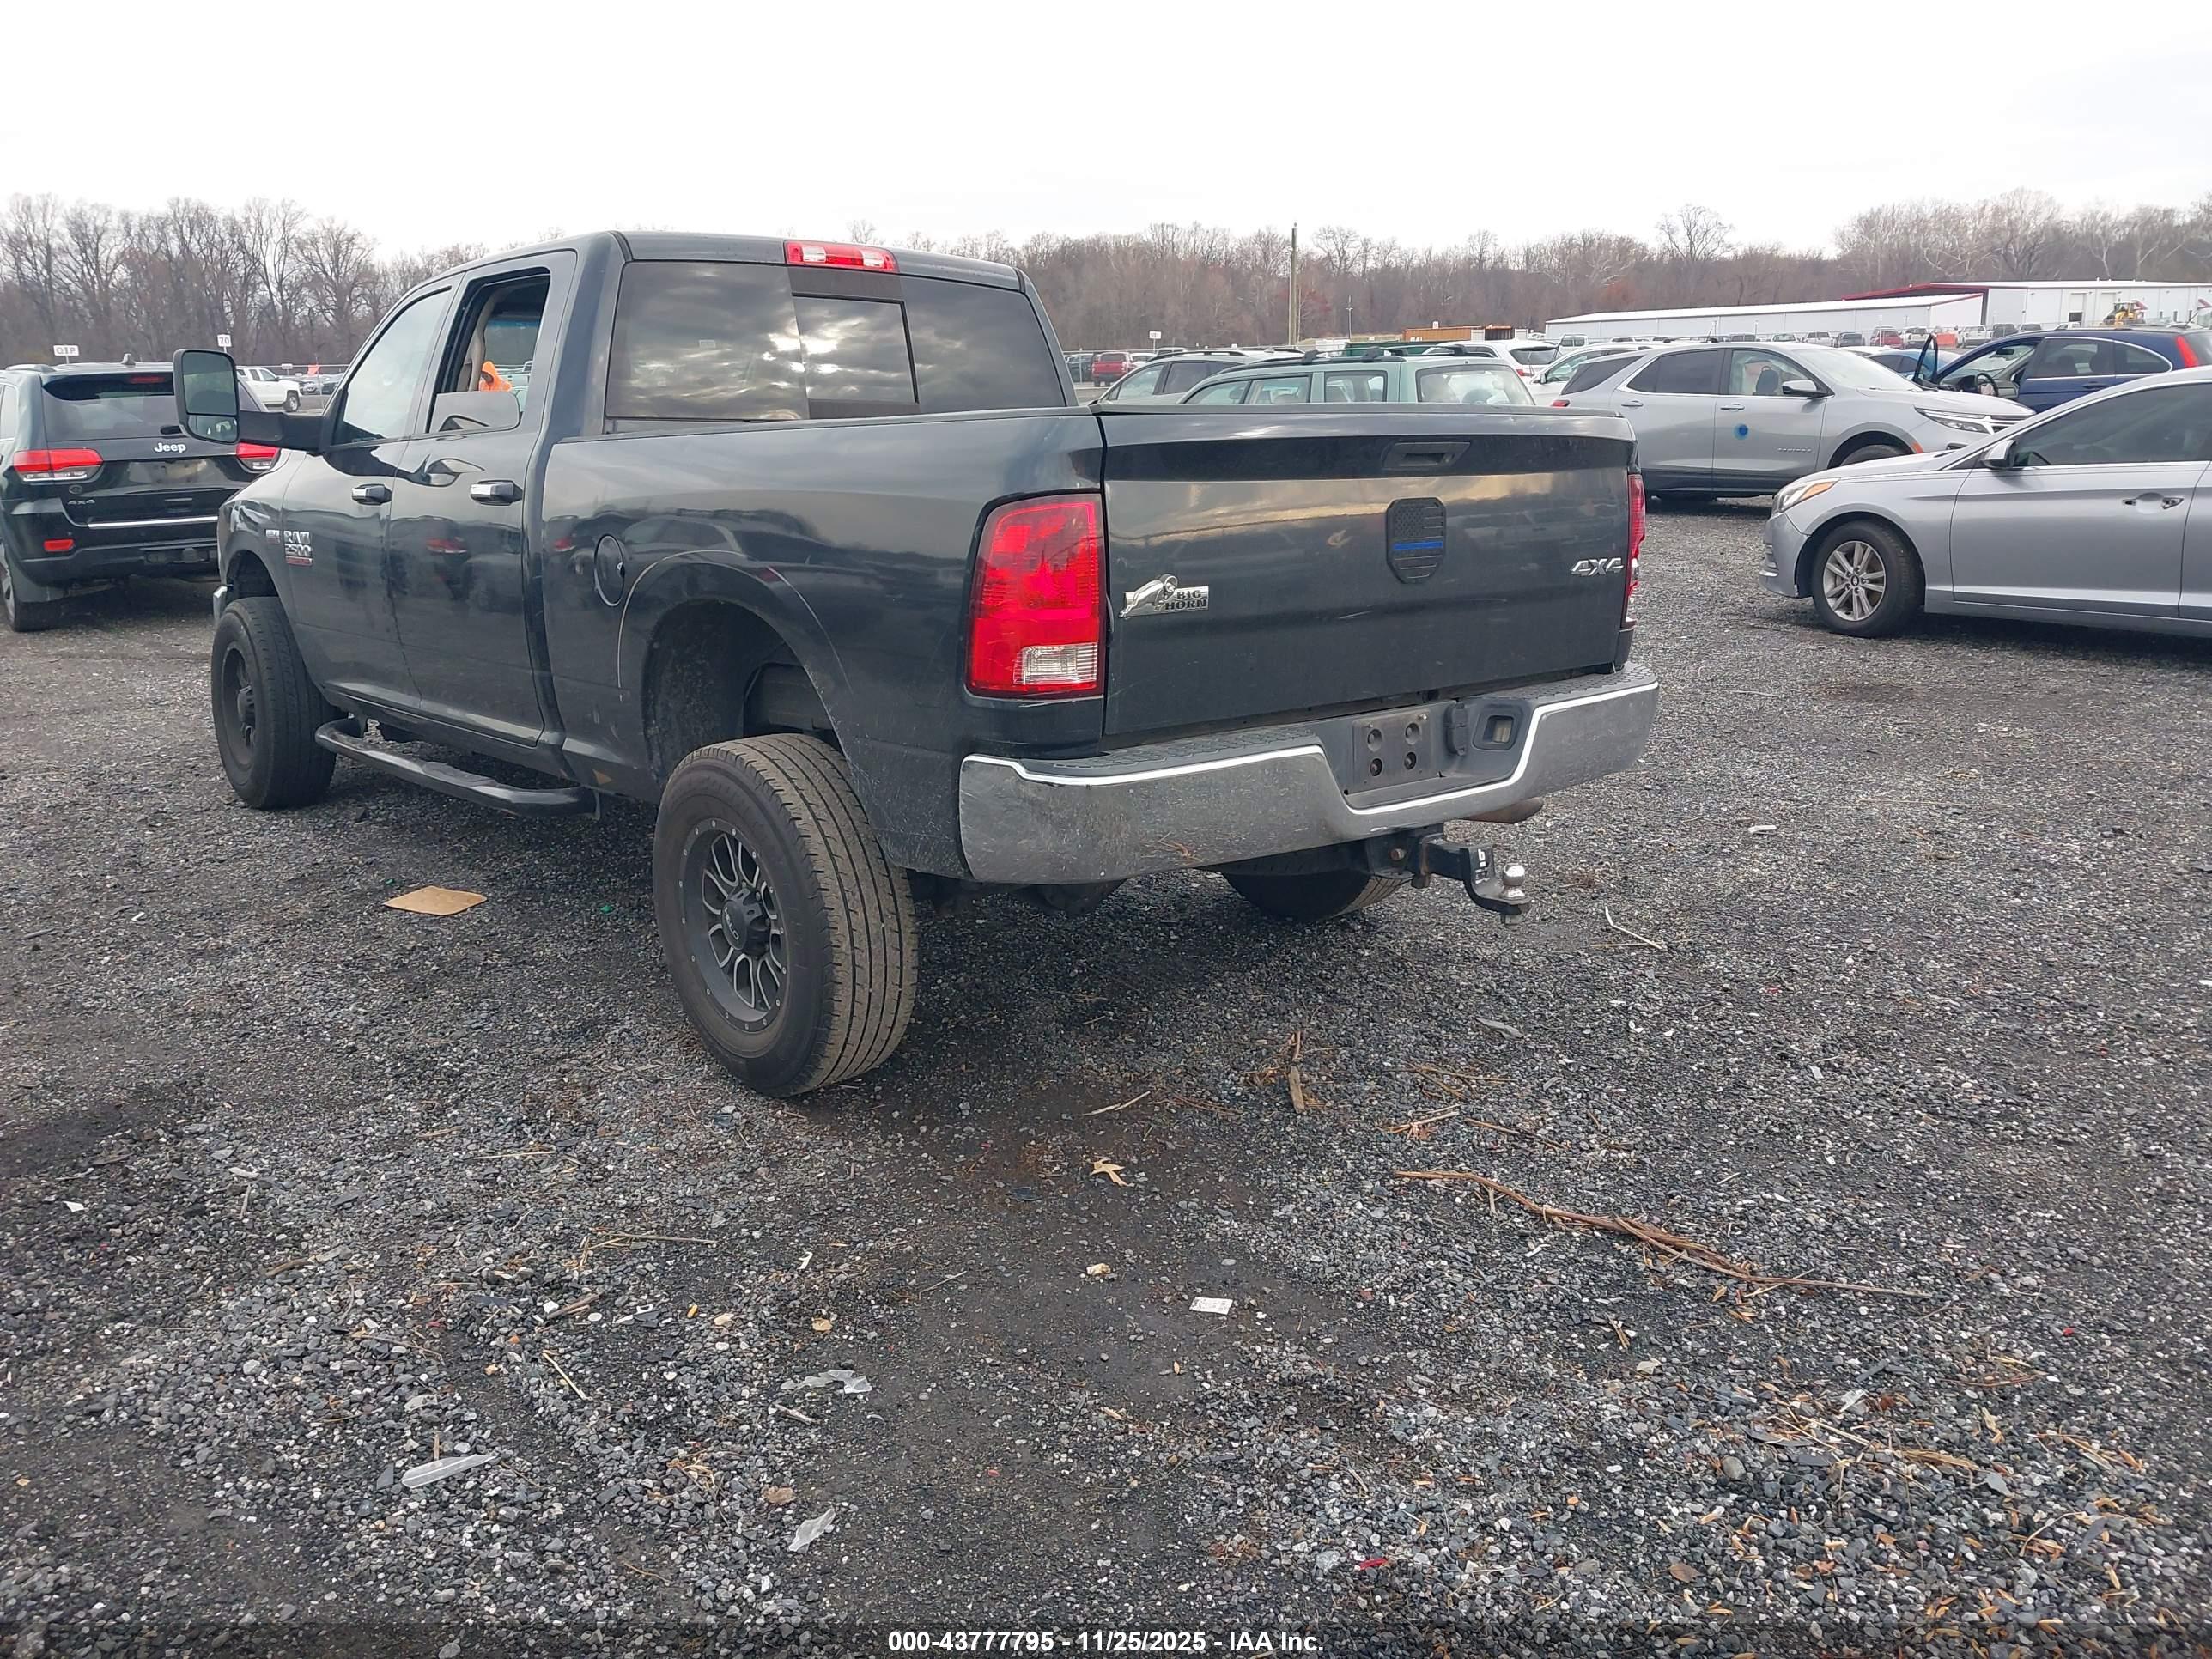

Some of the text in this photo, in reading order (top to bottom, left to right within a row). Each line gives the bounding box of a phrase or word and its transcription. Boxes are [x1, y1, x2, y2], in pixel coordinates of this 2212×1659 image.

[154, 442, 186, 453] Jeep
[1177, 590, 1201, 599] BIG
[1166, 599, 1206, 611] HORN
